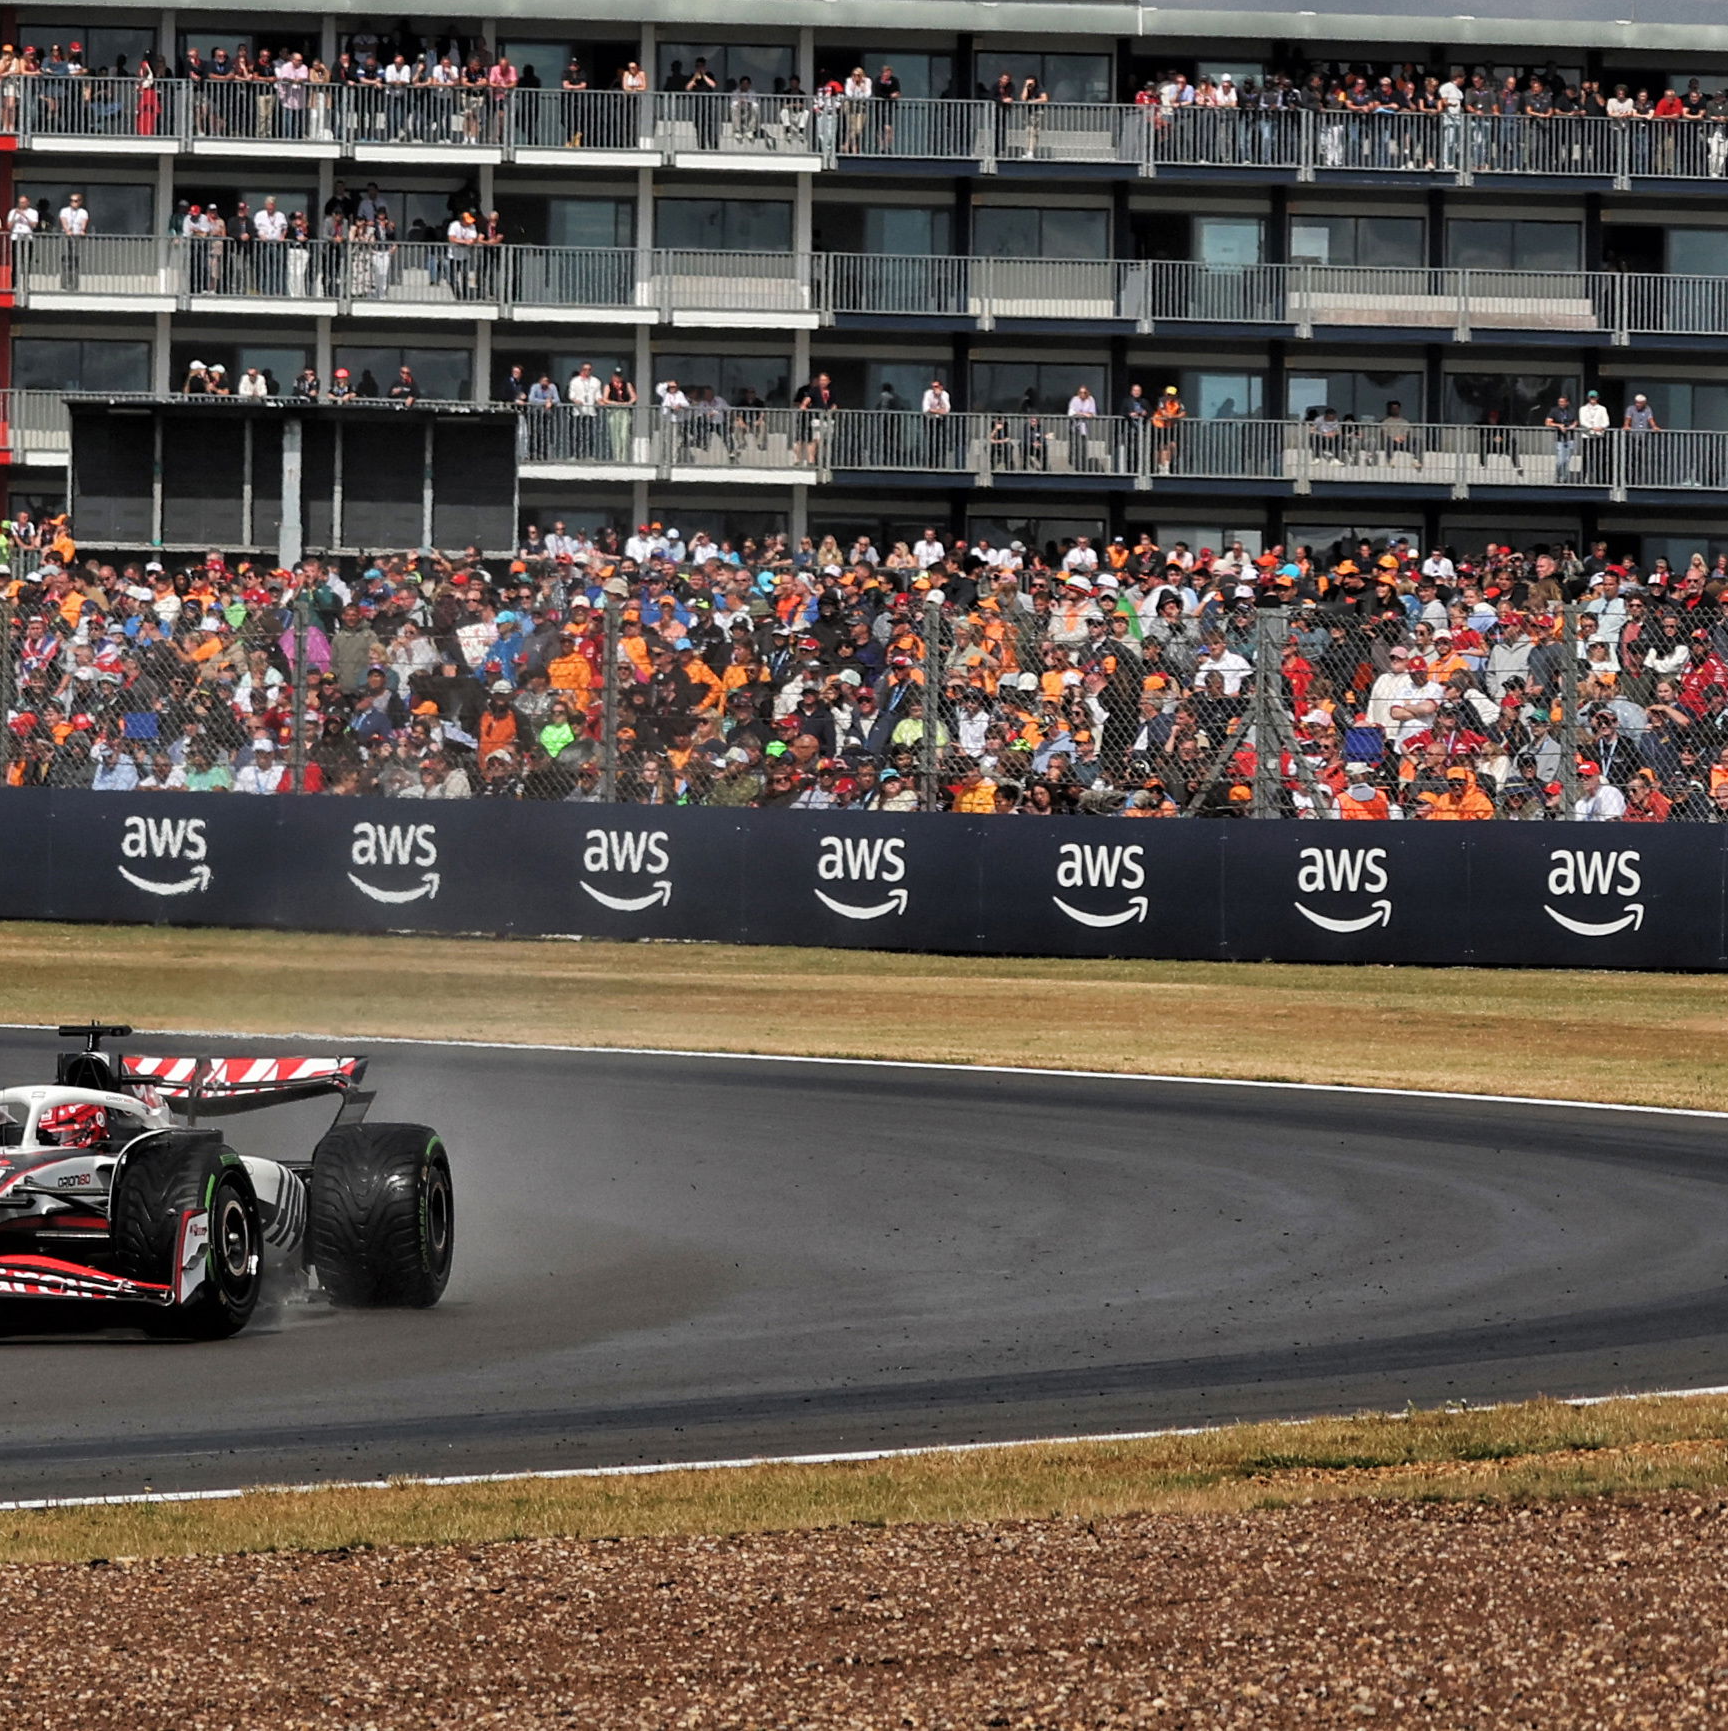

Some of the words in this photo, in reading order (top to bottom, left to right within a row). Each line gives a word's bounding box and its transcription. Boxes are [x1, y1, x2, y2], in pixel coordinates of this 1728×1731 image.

[120, 815, 208, 861] aws
[351, 821, 438, 868] aws
[583, 828, 670, 875] aws
[817, 835, 905, 882] aws
[1056, 843, 1145, 890] aws
[1297, 847, 1388, 893] aws
[1548, 849, 1641, 897] aws
